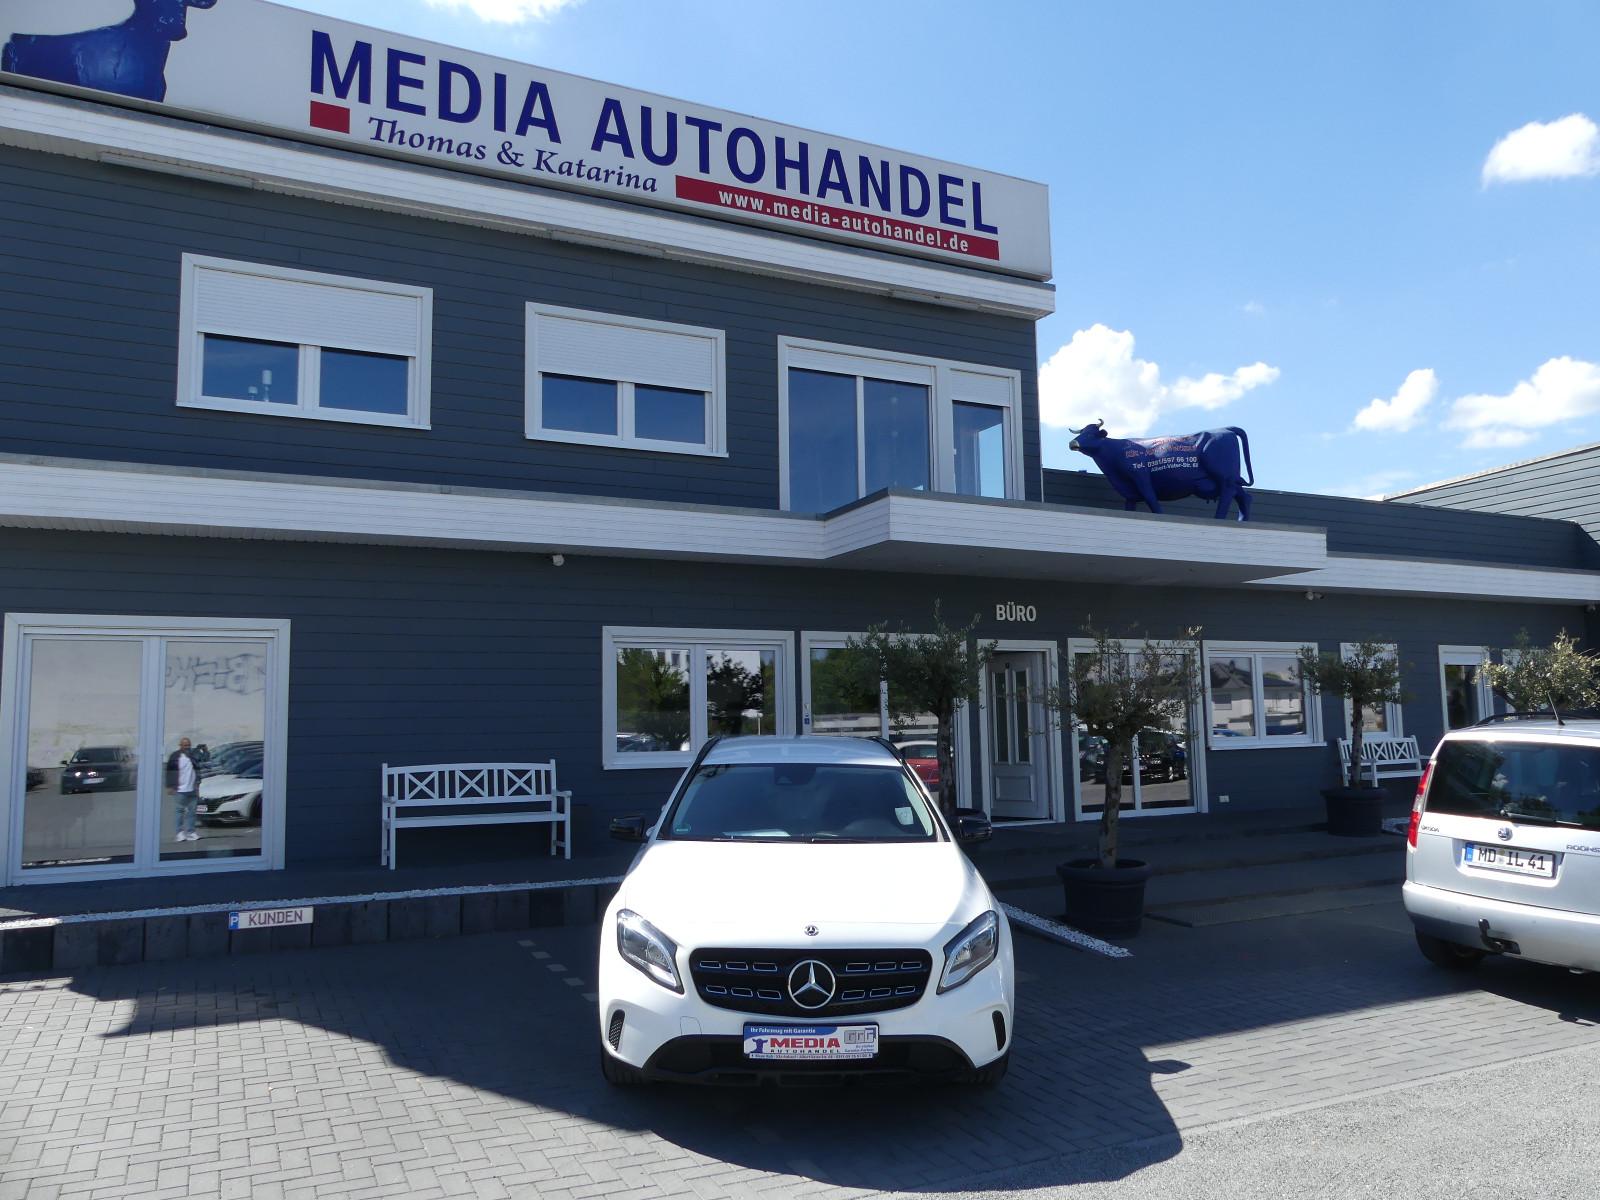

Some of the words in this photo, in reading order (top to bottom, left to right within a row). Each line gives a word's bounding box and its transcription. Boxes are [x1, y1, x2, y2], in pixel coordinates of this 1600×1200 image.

[310, 30, 561, 145] MEDIA
[591, 97, 999, 235] AUTOHANDEL
[369, 117, 487, 161] Thomas
[497, 141, 525, 168] &
[533, 149, 659, 194] Katarina
[718, 189, 970, 253] www.media-autohandel.de
[996, 601, 1037, 622] BÜRO
[1478, 847, 1496, 863] MD
[1506, 852, 1524, 867] IL
[1528, 854, 1546, 871] 41
[230, 916, 238, 926] P
[248, 909, 304, 926] KUNDEN
[770, 1037, 841, 1049] MEDIA
